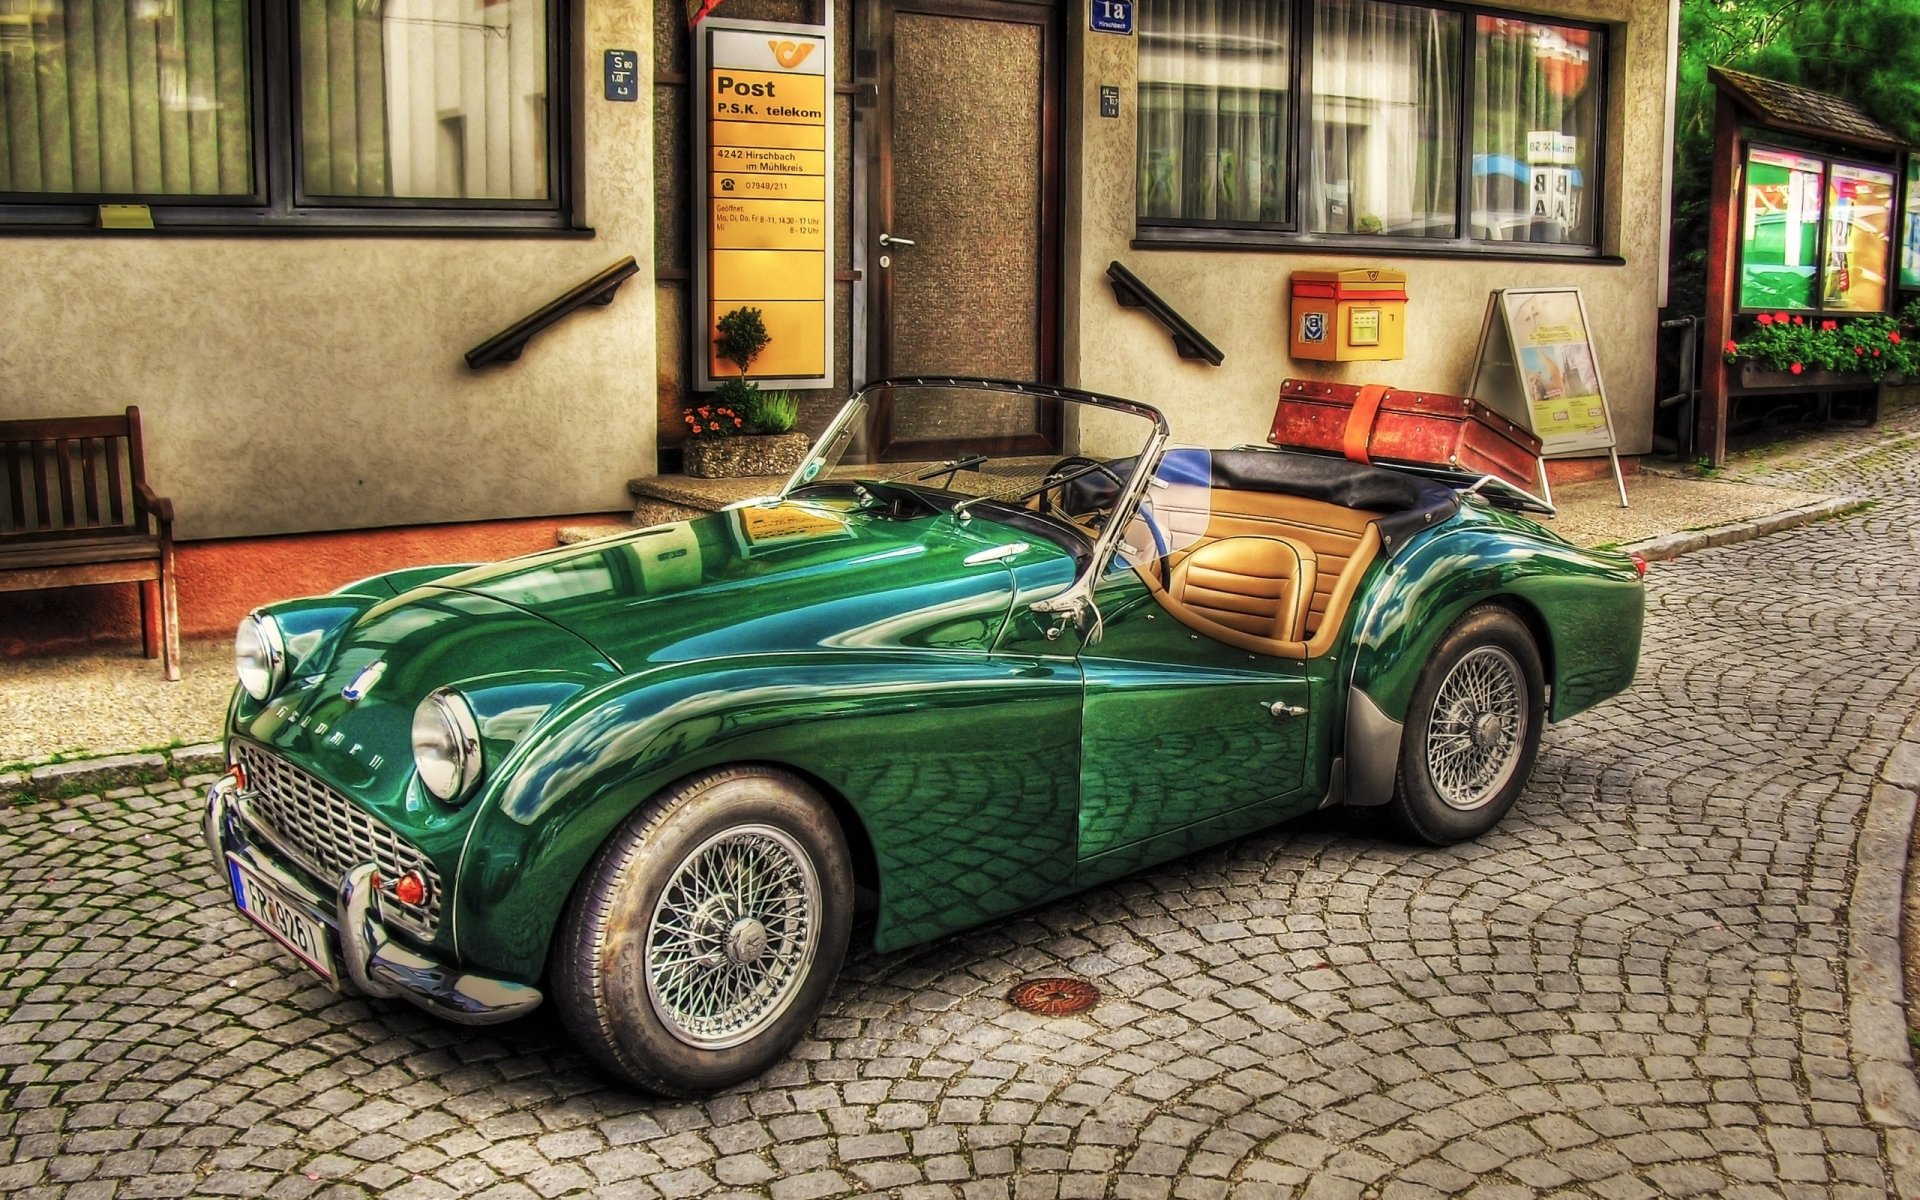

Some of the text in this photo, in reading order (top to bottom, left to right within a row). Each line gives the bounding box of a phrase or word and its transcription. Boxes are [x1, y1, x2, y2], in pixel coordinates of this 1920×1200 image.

[1104, 1, 1125, 20] 1a
[1099, 20, 1126, 29] Hirschbach
[717, 76, 776, 98] Post
[717, 102, 822, 118] P.S.K. telekom
[717, 149, 796, 161] 4242 Hirschbach
[745, 162, 804, 173] im Mühlkreis
[745, 181, 788, 191] 07948/211
[247, 878, 270, 924] FR
